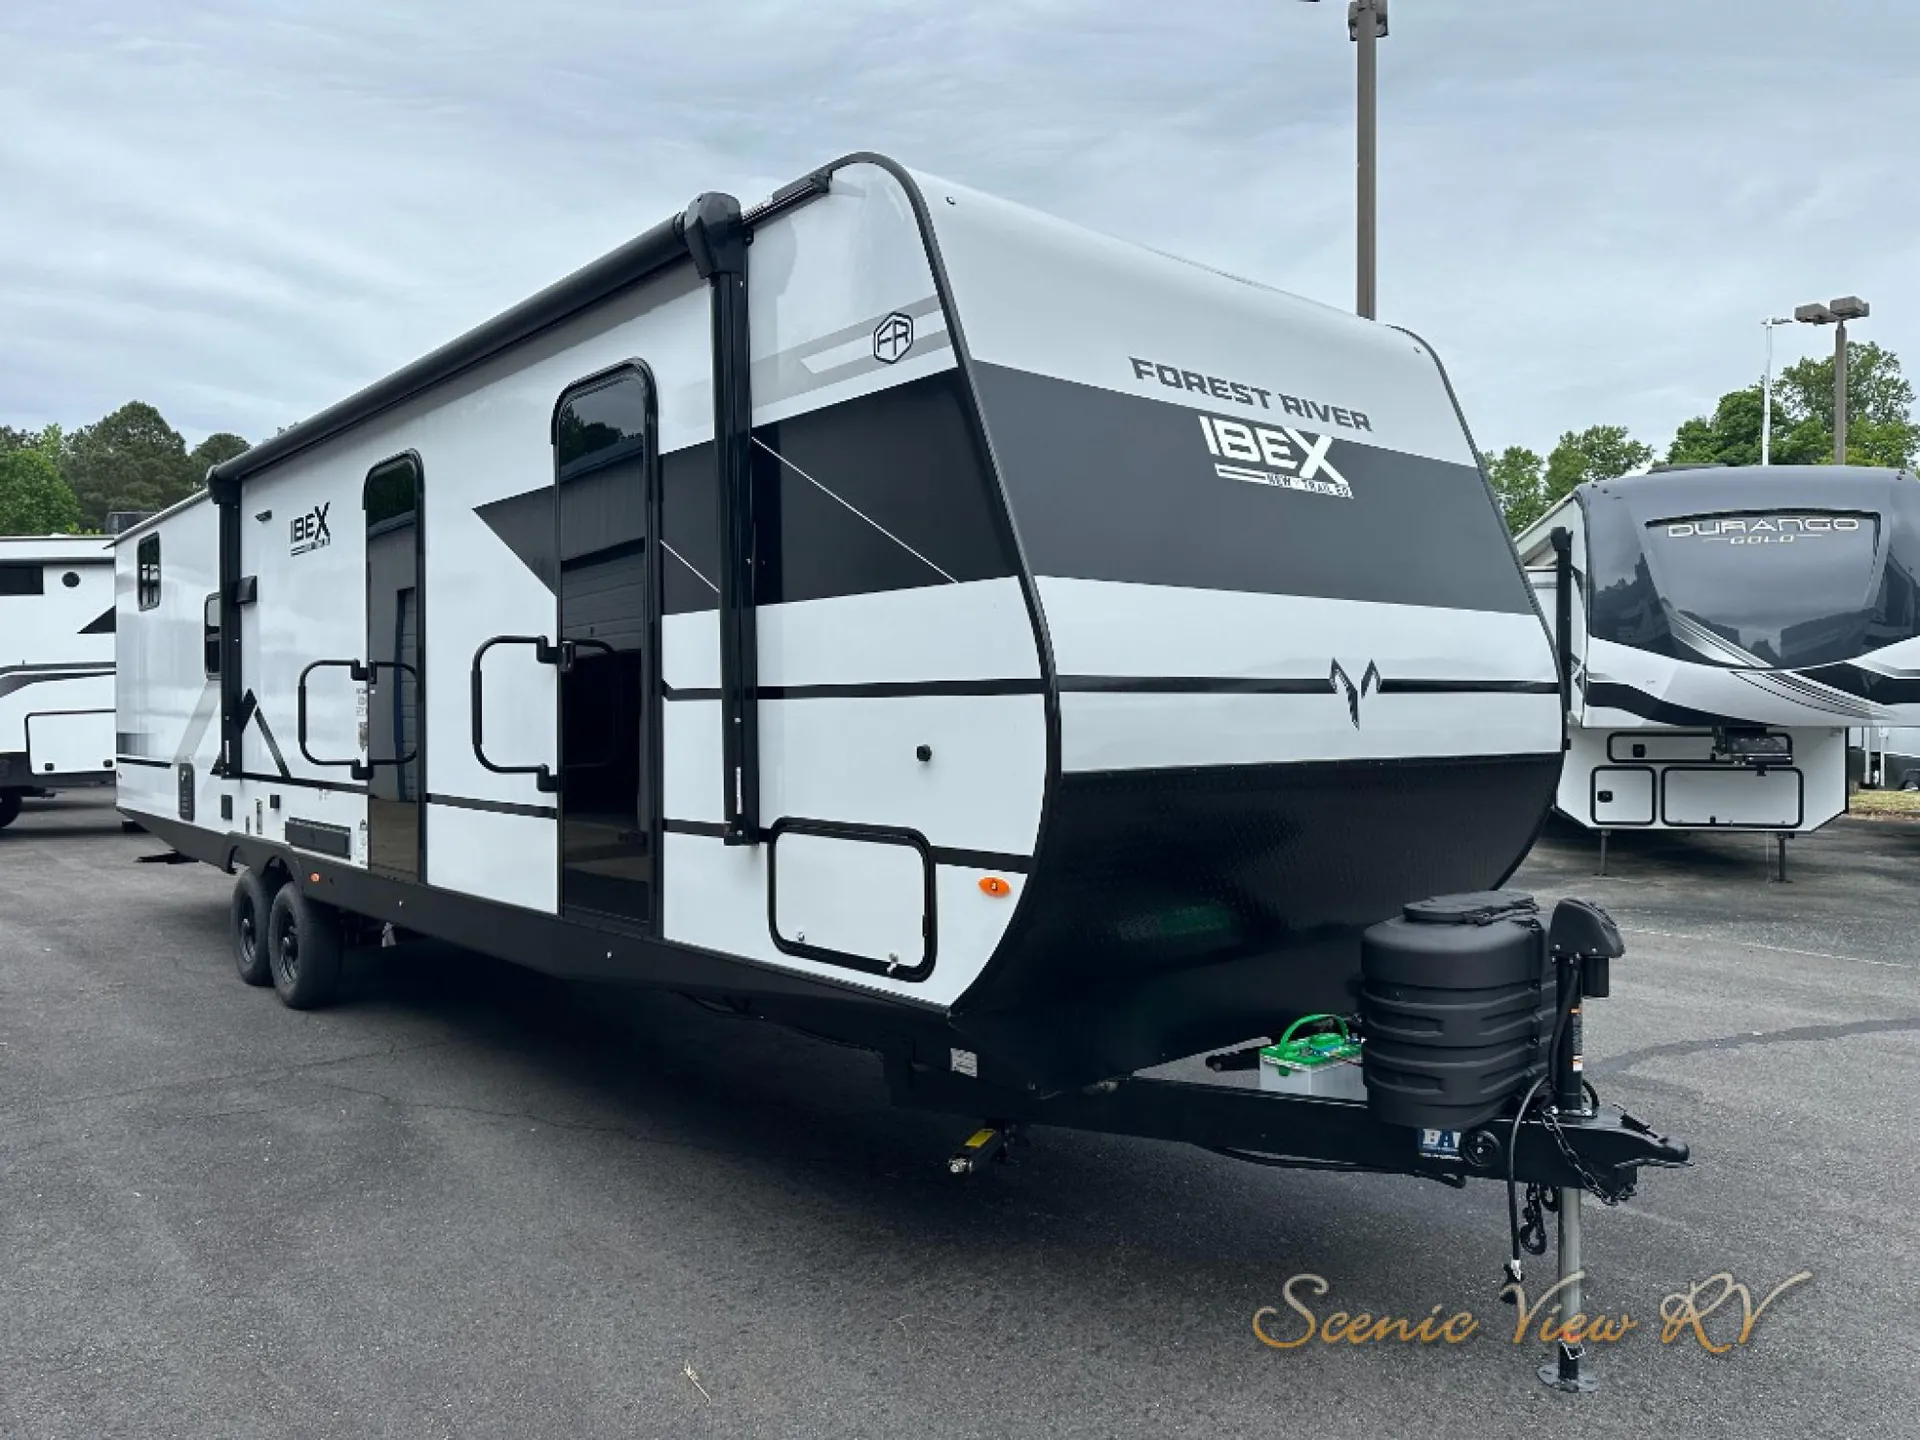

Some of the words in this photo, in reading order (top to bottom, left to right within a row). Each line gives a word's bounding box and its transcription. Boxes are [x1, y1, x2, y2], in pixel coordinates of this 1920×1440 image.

[1128, 355, 1271, 410] FOREST
[1278, 393, 1373, 431] RIVER
[1198, 411, 1349, 486] IBEX
[289, 500, 331, 544] IBEX
[1667, 518, 1861, 538] DURANGO
[1729, 534, 1795, 545] GOLD
